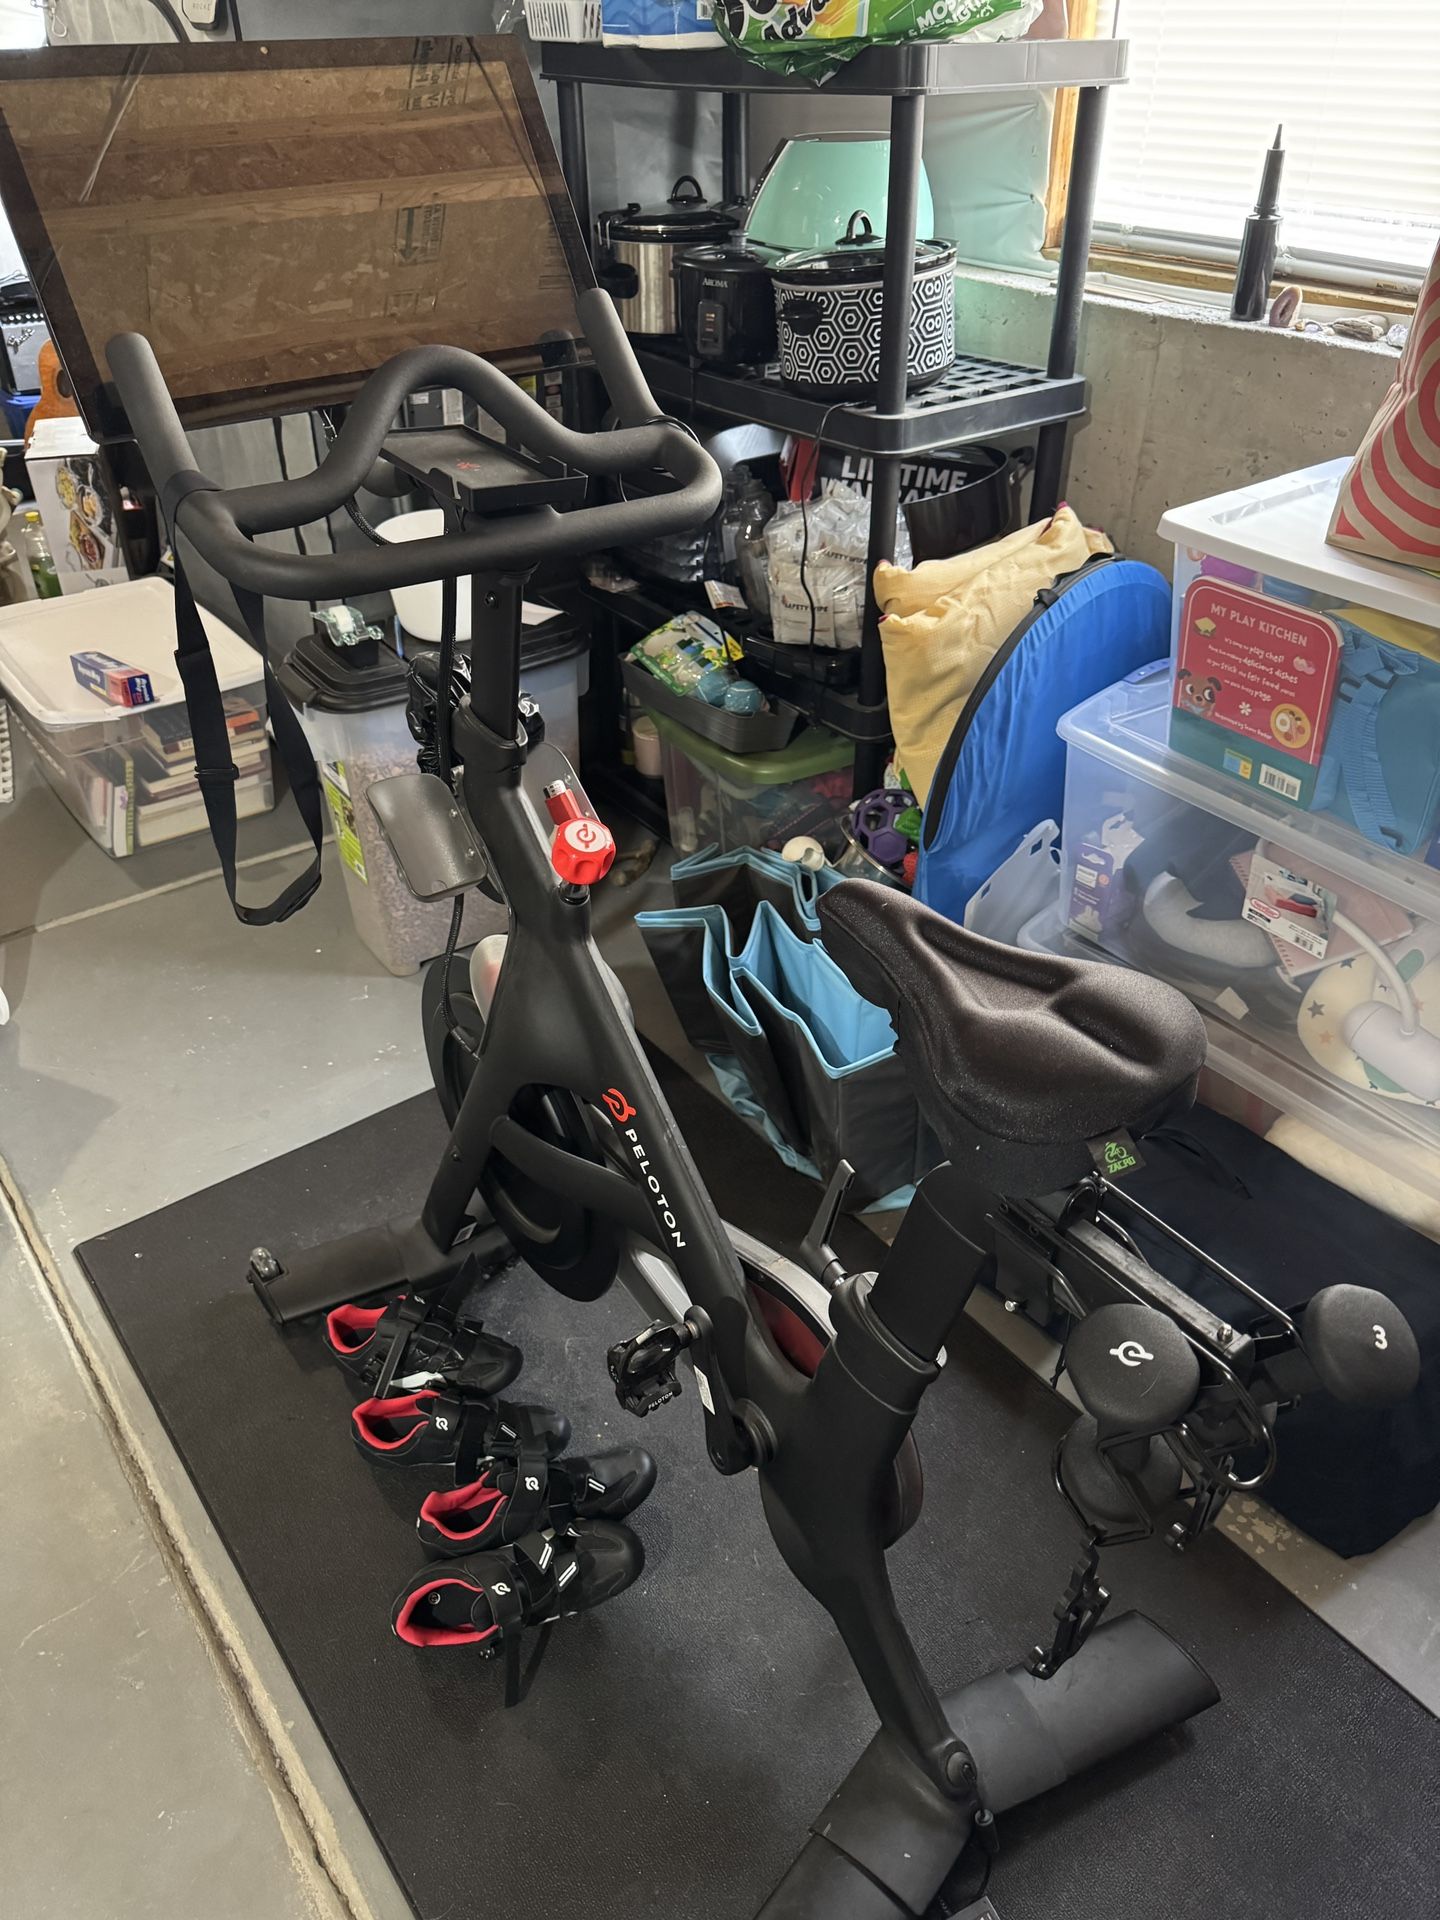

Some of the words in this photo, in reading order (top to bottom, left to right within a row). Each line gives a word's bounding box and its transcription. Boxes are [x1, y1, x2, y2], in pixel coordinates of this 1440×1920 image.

[702, 277, 729, 288] AROMA
[841, 455, 968, 493] LITIME
[1210, 603, 1227, 617] MY
[1229, 610, 1256, 628] PLAY
[1259, 620, 1308, 647] KITCHEN
[1243, 656, 1274, 675] delicious
[1274, 668, 1299, 684] dishes
[625, 1128, 687, 1248] PELOTON
[1372, 1324, 1388, 1350] 3
[648, 1390, 674, 1409] PELOTON
